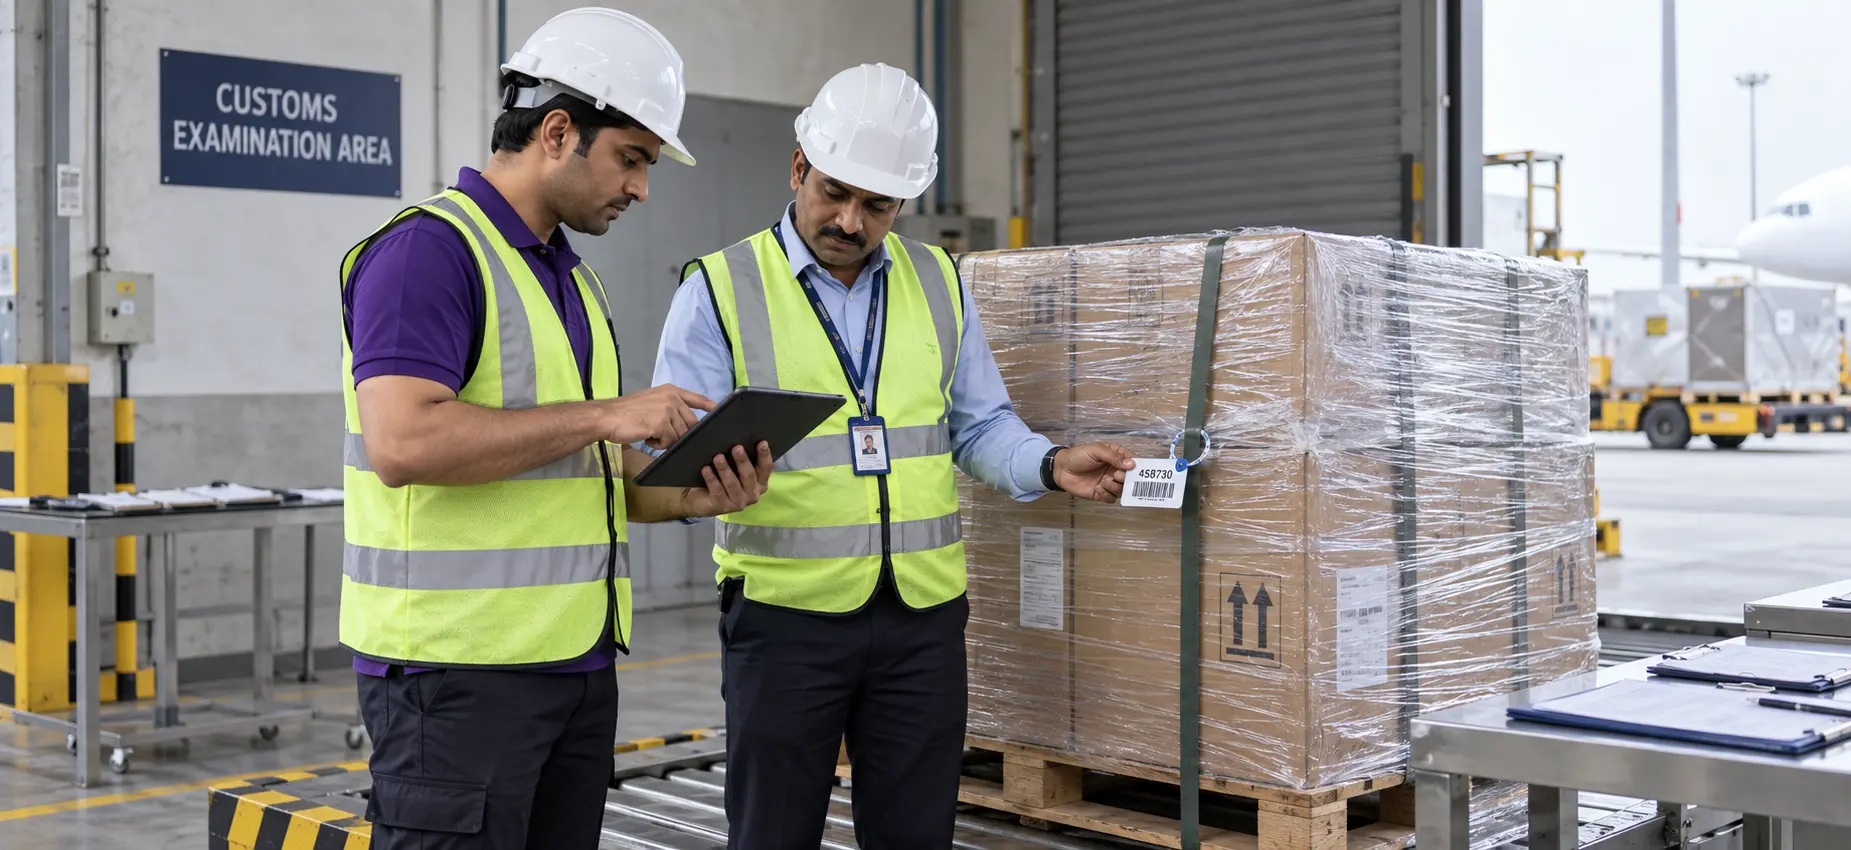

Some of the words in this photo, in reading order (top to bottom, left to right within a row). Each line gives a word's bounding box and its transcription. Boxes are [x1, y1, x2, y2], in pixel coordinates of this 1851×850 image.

[216, 82, 338, 123] CUSTOMS
[173, 120, 331, 161] EXAMINATION
[336, 133, 393, 166] AREA
[1138, 469, 1173, 480] 458730
